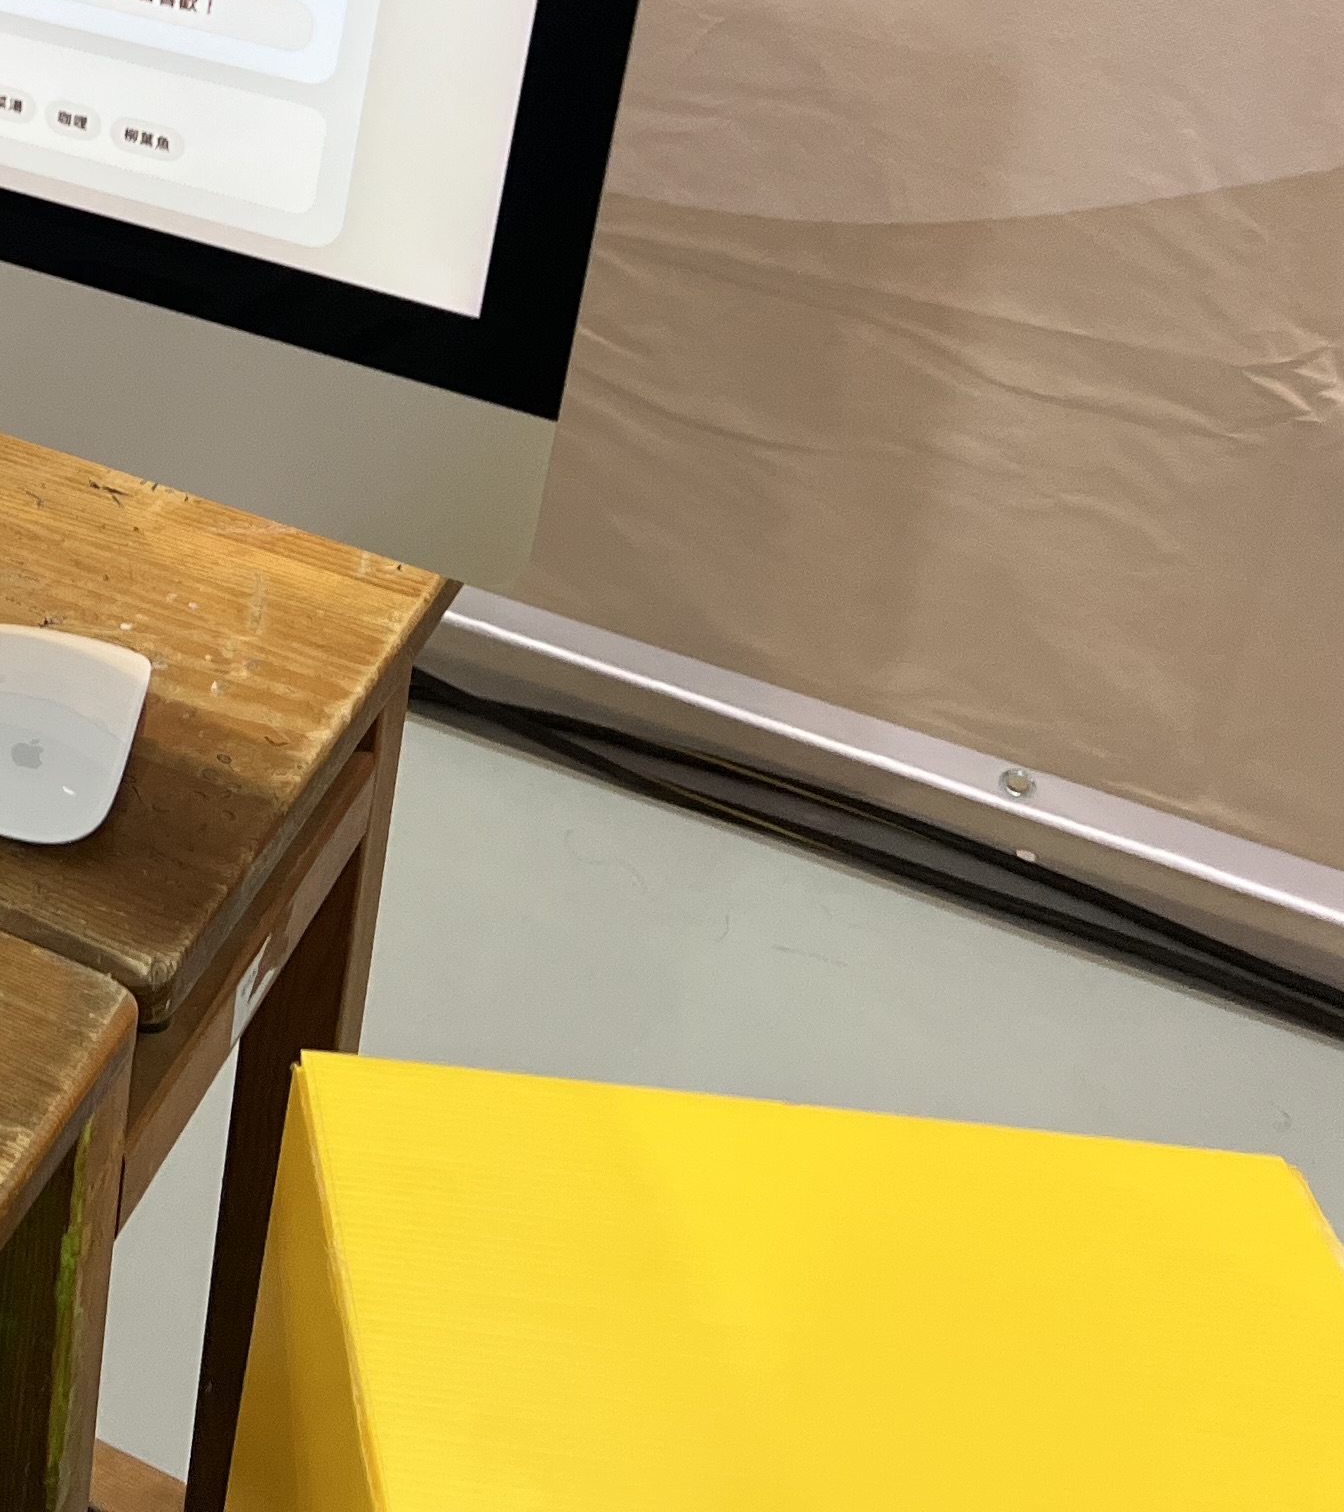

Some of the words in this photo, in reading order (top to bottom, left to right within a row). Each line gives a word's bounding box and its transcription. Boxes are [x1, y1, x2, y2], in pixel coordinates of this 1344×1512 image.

[56, 110, 88, 132] 咖哩
[123, 126, 171, 153] 柳葉魚
